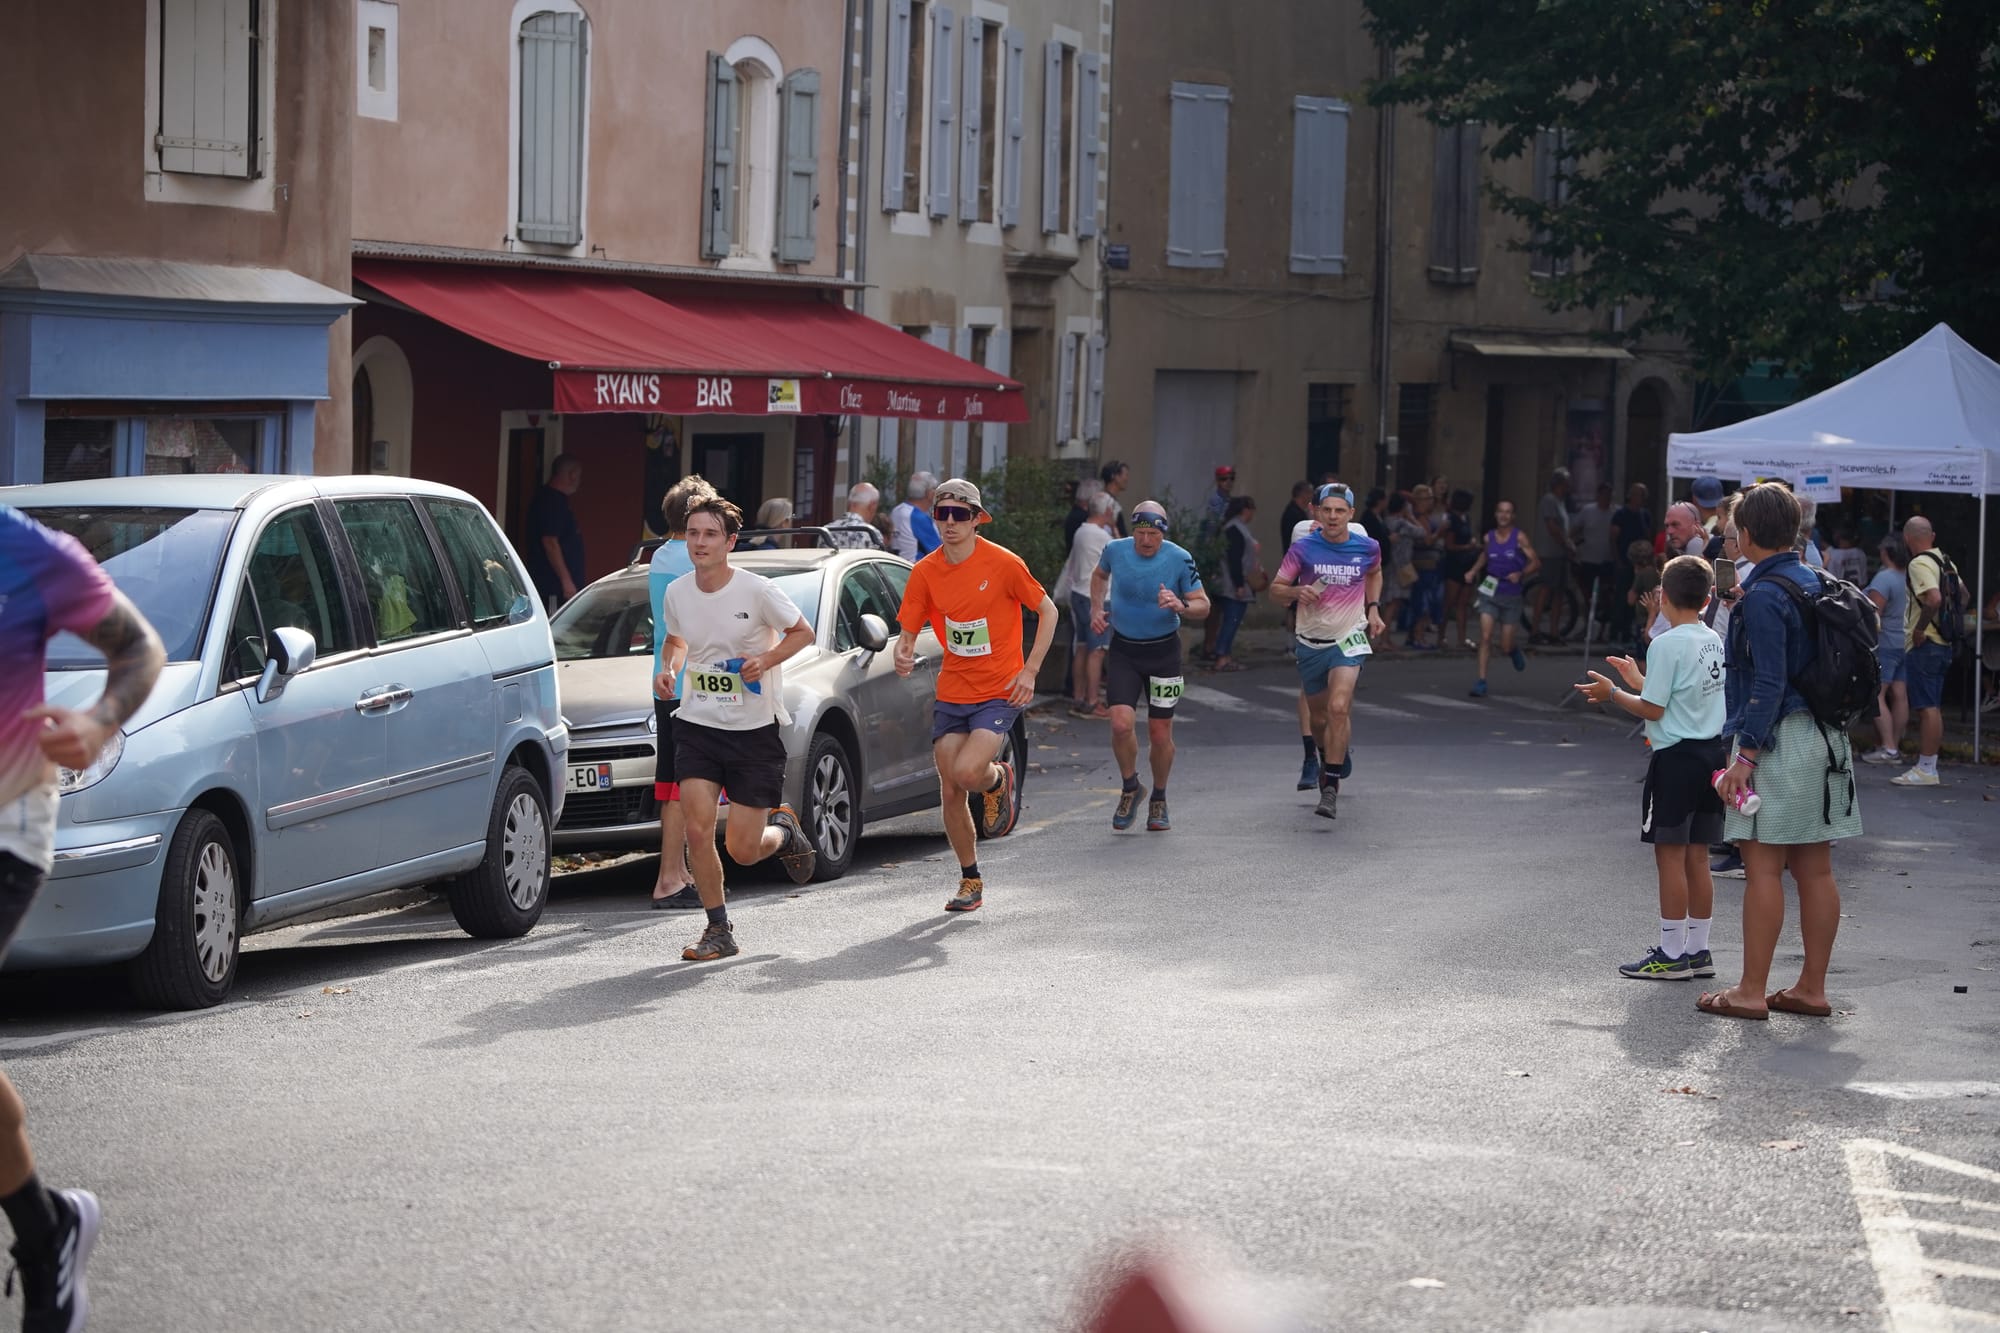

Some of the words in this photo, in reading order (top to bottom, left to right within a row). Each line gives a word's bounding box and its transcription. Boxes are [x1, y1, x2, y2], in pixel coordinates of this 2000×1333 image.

[597, 374, 660, 404] RYAN'S
[697, 378, 732, 407] BAR
[840, 384, 863, 408] Chez
[887, 390, 921, 412] Martine
[937, 397, 945, 413] et
[963, 393, 983, 419] John
[1314, 564, 1361, 576] MARVEJOLS
[952, 630, 975, 645] 97
[697, 674, 733, 692] 189
[1154, 685, 1180, 698] 120
